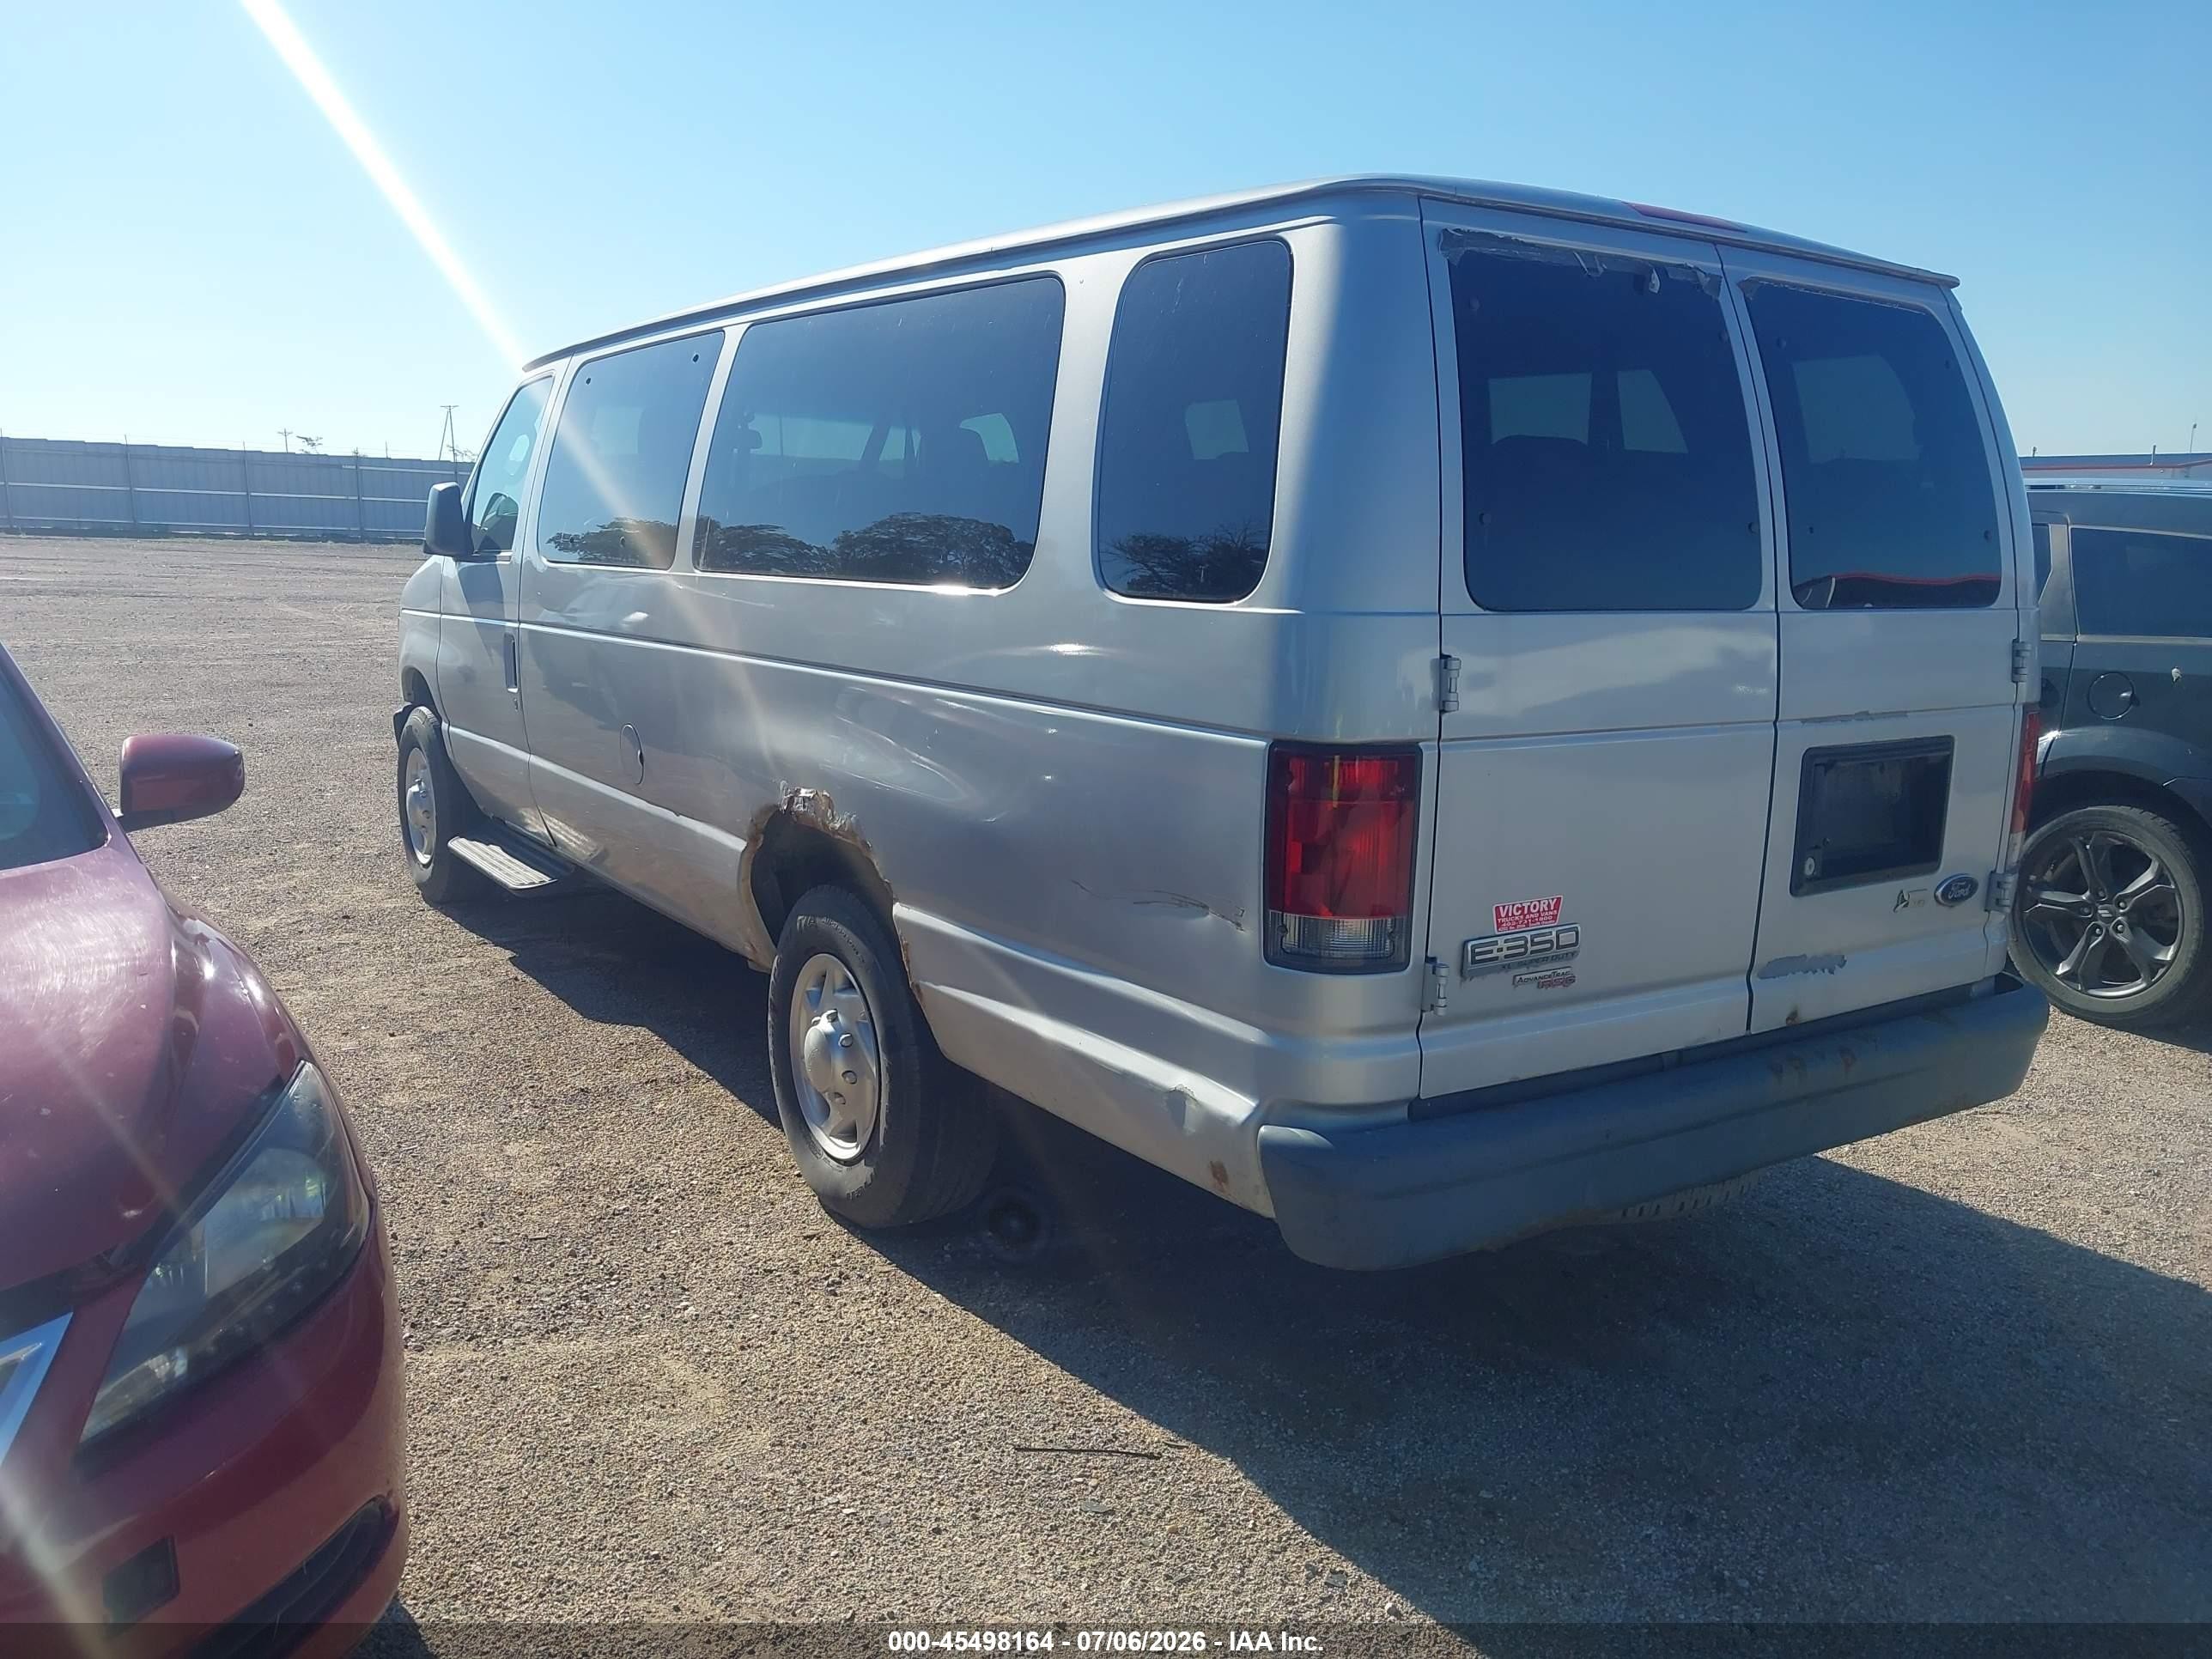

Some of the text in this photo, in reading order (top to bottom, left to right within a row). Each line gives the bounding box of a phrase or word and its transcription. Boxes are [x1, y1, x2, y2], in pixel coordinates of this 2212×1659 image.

[1948, 881, 1972, 899] Ford
[1499, 898, 1558, 918] VICTORY
[1498, 915, 1523, 923] TRUCKS
[1471, 927, 1579, 965] E-350
